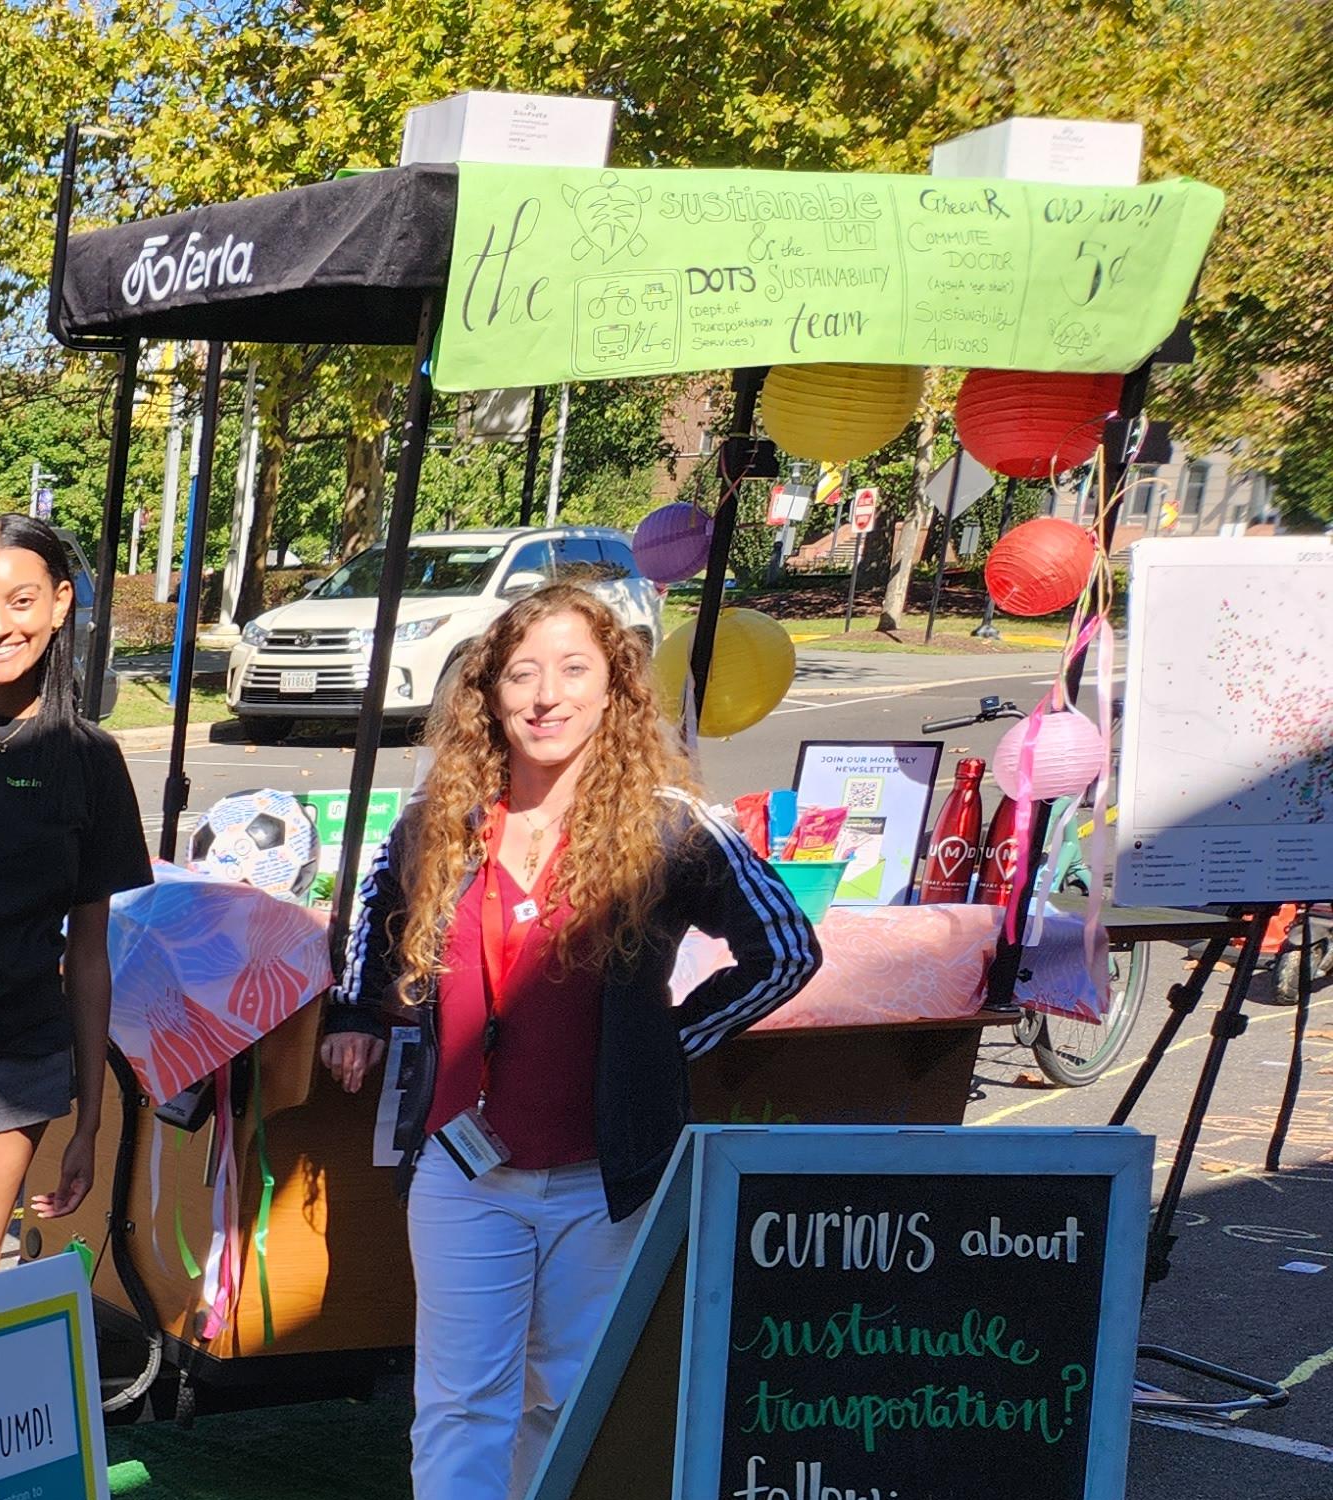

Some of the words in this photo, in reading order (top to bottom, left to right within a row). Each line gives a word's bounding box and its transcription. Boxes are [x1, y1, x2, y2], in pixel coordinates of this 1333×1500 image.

[829, 222, 872, 246] UMD
[464, 197, 553, 331] the
[685, 266, 756, 295] DOTS
[728, 301, 741, 314] of
[784, 302, 870, 354] team
[821, 756, 843, 764] JOIN
[846, 756, 867, 764] OUR
[869, 756, 918, 764] MONTHLY
[835, 766, 900, 774] NEWSLETTER
[960, 1216, 1085, 1264] about
[734, 1303, 1039, 1365] sustainable
[740, 1364, 1088, 1452] transportation?
[32, 1482, 42, 1498] to
